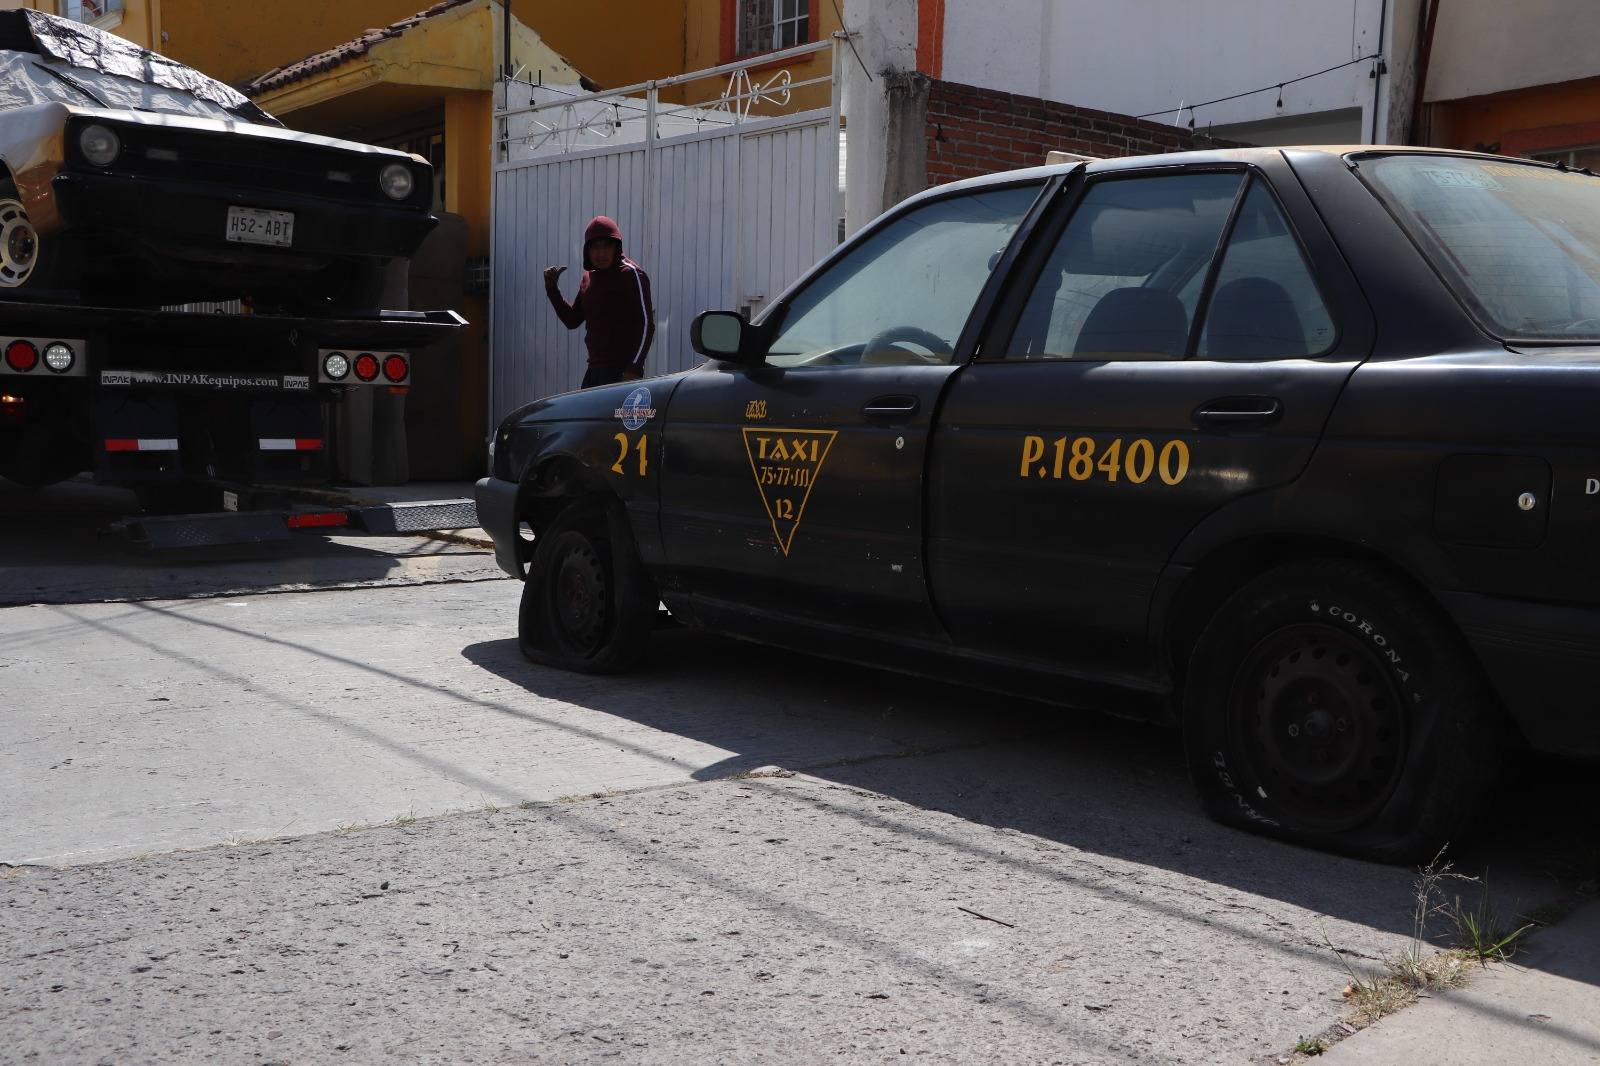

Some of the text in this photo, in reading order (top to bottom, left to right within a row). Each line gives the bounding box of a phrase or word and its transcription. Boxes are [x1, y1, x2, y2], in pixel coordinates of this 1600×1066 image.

[231, 216, 290, 237] H52-ABT
[102, 374, 131, 385] INPAK
[284, 378, 309, 388] INPAK
[610, 432, 649, 476] 21
[756, 437, 820, 462] TAXI
[1020, 434, 1190, 486] P.18400
[775, 497, 794, 520] 12
[1328, 605, 1411, 683] CORONA
